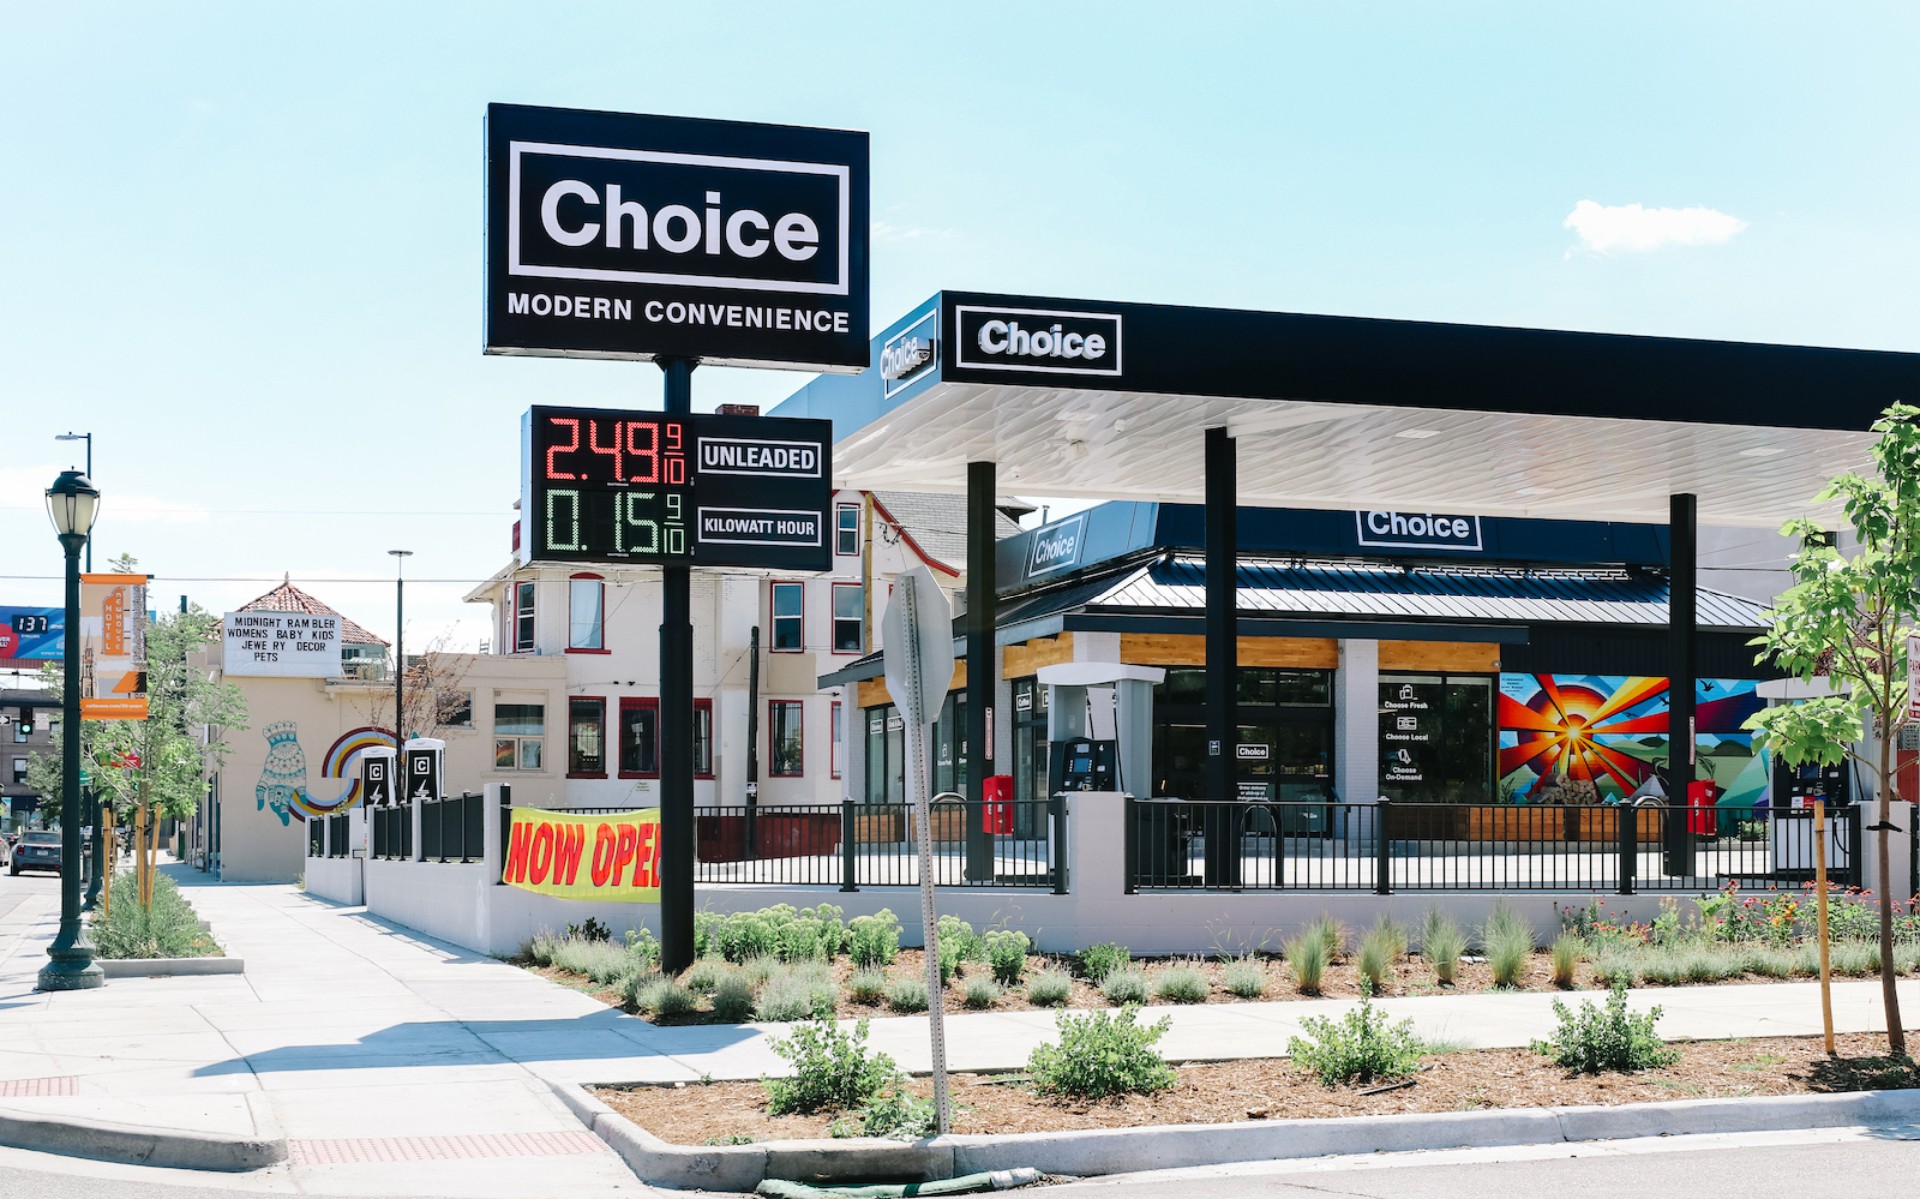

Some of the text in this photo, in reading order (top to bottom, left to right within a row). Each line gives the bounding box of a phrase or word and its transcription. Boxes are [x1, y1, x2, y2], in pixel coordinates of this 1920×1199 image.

[540, 178, 819, 262] Choice
[508, 292, 849, 333] MODERN CONVENIENCE
[977, 319, 1106, 360] Choice
[880, 336, 919, 380] Choice
[546, 417, 659, 484] 2.49
[704, 444, 815, 470] UNLEADED
[546, 488, 659, 554] 0.15
[704, 517, 815, 536] KILOWATT HOUR
[1366, 511, 1470, 539] Choice
[1035, 533, 1075, 566] Choice
[19, 616, 48, 632] 137
[105, 604, 113, 650] HOTEL
[234, 616, 282, 628] MIDNIGHT
[227, 628, 334, 640] WOMENS BABY KIDS
[296, 641, 326, 652] DECOR
[253, 652, 278, 662] PETS
[1384, 701, 1428, 709] Choose Fresh
[1098, 744, 1105, 752] 4
[1239, 747, 1266, 756] Choice
[372, 766, 380, 777] C
[417, 760, 427, 771] C
[1392, 766, 1417, 774] Choose
[1385, 773, 1423, 781] On-Demand
[505, 821, 585, 886] NOW
